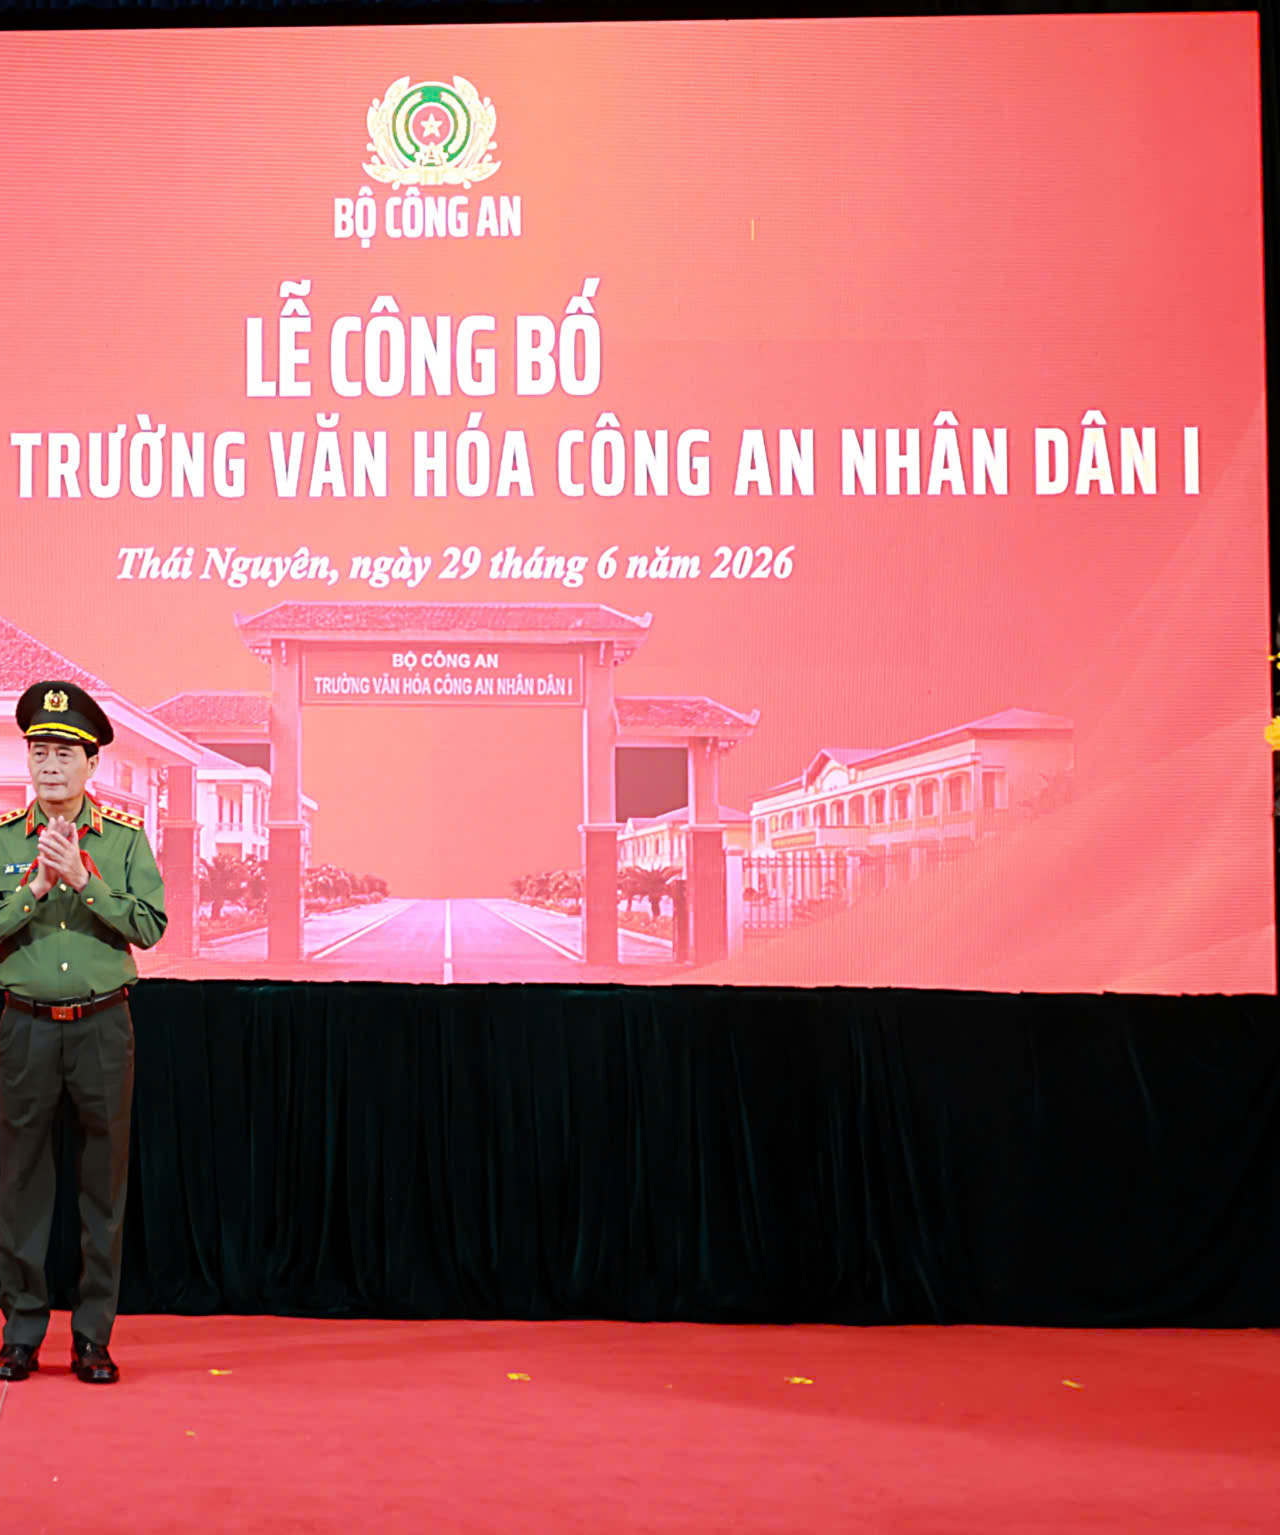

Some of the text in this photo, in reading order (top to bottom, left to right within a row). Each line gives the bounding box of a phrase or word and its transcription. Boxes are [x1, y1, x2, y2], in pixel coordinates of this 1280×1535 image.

[334, 186, 521, 248] BỘ CÔNG AN
[246, 277, 602, 397] LỄ CÔNG BỐ
[11, 414, 247, 500] TRƯỜNG
[270, 414, 390, 498] VĂN
[413, 411, 535, 498] HÓA
[555, 412, 711, 498] CÔNG
[733, 427, 815, 497] AN
[841, 410, 1009, 496] NHÂN
[1035, 409, 1157, 496] DÂN
[1183, 425, 1201, 496] I
[117, 546, 795, 588] Thái Nguyên, ngày 29 tháng 6 năm 2026
[372, 673, 400, 694] VĂN
[403, 672, 431, 695] HÓA
[433, 672, 472, 695] CÔNG
[474, 677, 494, 695] AN
[497, 673, 534, 695] NHÂN
[537, 673, 565, 695] DÂN
[568, 677, 573, 696] I
[392, 650, 499, 671] BỘ CÔNG AN
